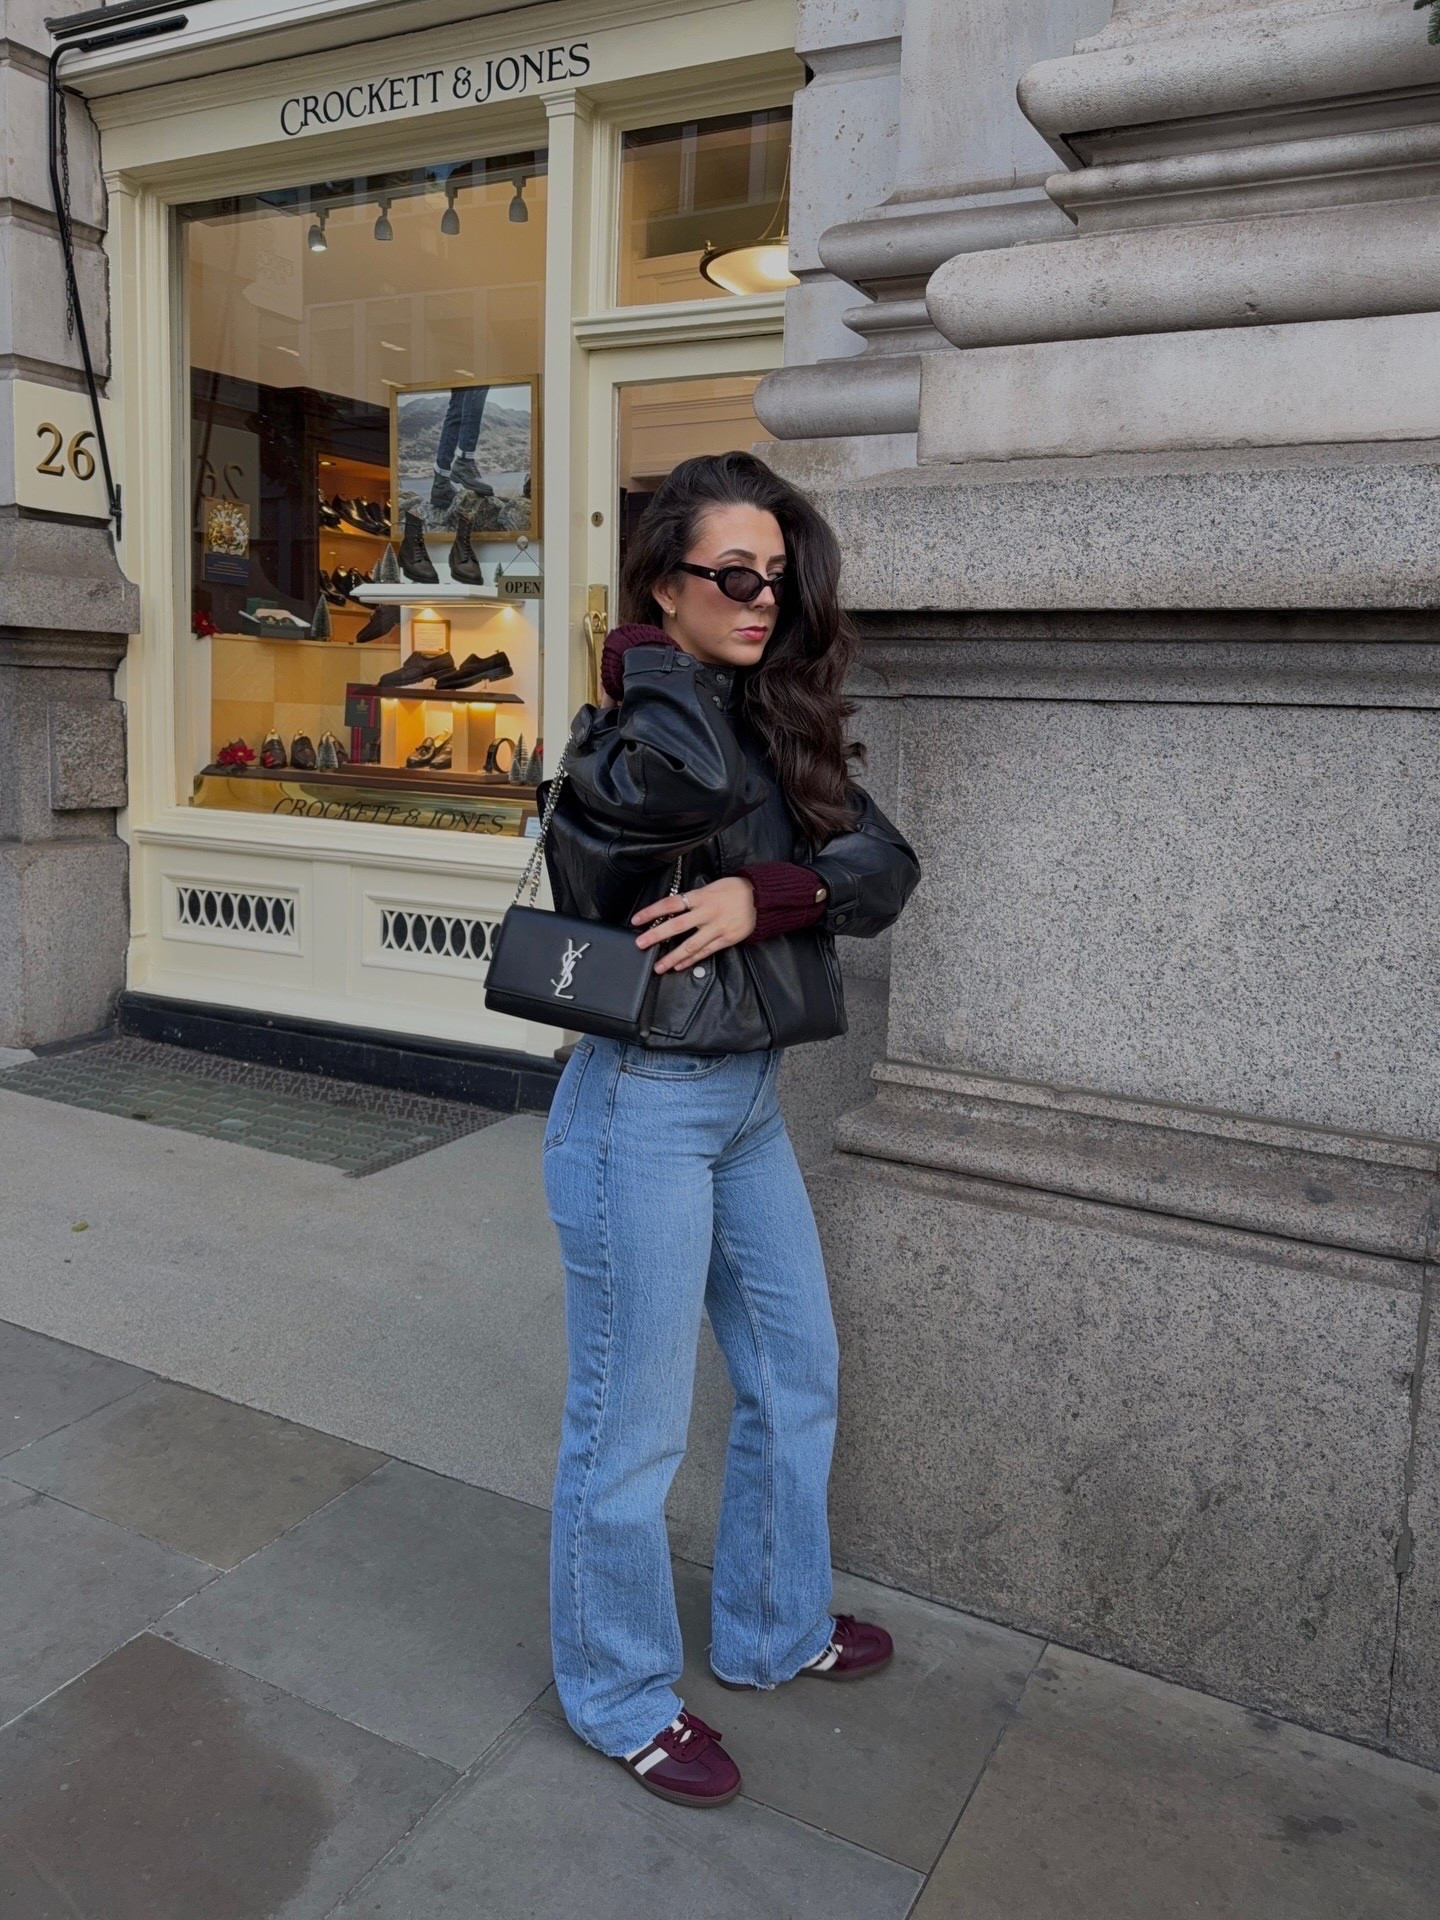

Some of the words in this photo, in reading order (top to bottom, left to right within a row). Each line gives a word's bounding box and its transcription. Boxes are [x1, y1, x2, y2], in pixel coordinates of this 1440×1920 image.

[280, 70, 444, 136] CROCKETT
[453, 66, 472, 99] &
[475, 42, 591, 103] JONES
[36, 422, 96, 481] 26
[505, 581, 541, 594] OPEN
[273, 798, 400, 825] CROCKETT
[403, 808, 421, 826] &
[427, 810, 506, 834] JONES
[550, 938, 591, 1000] YSL
